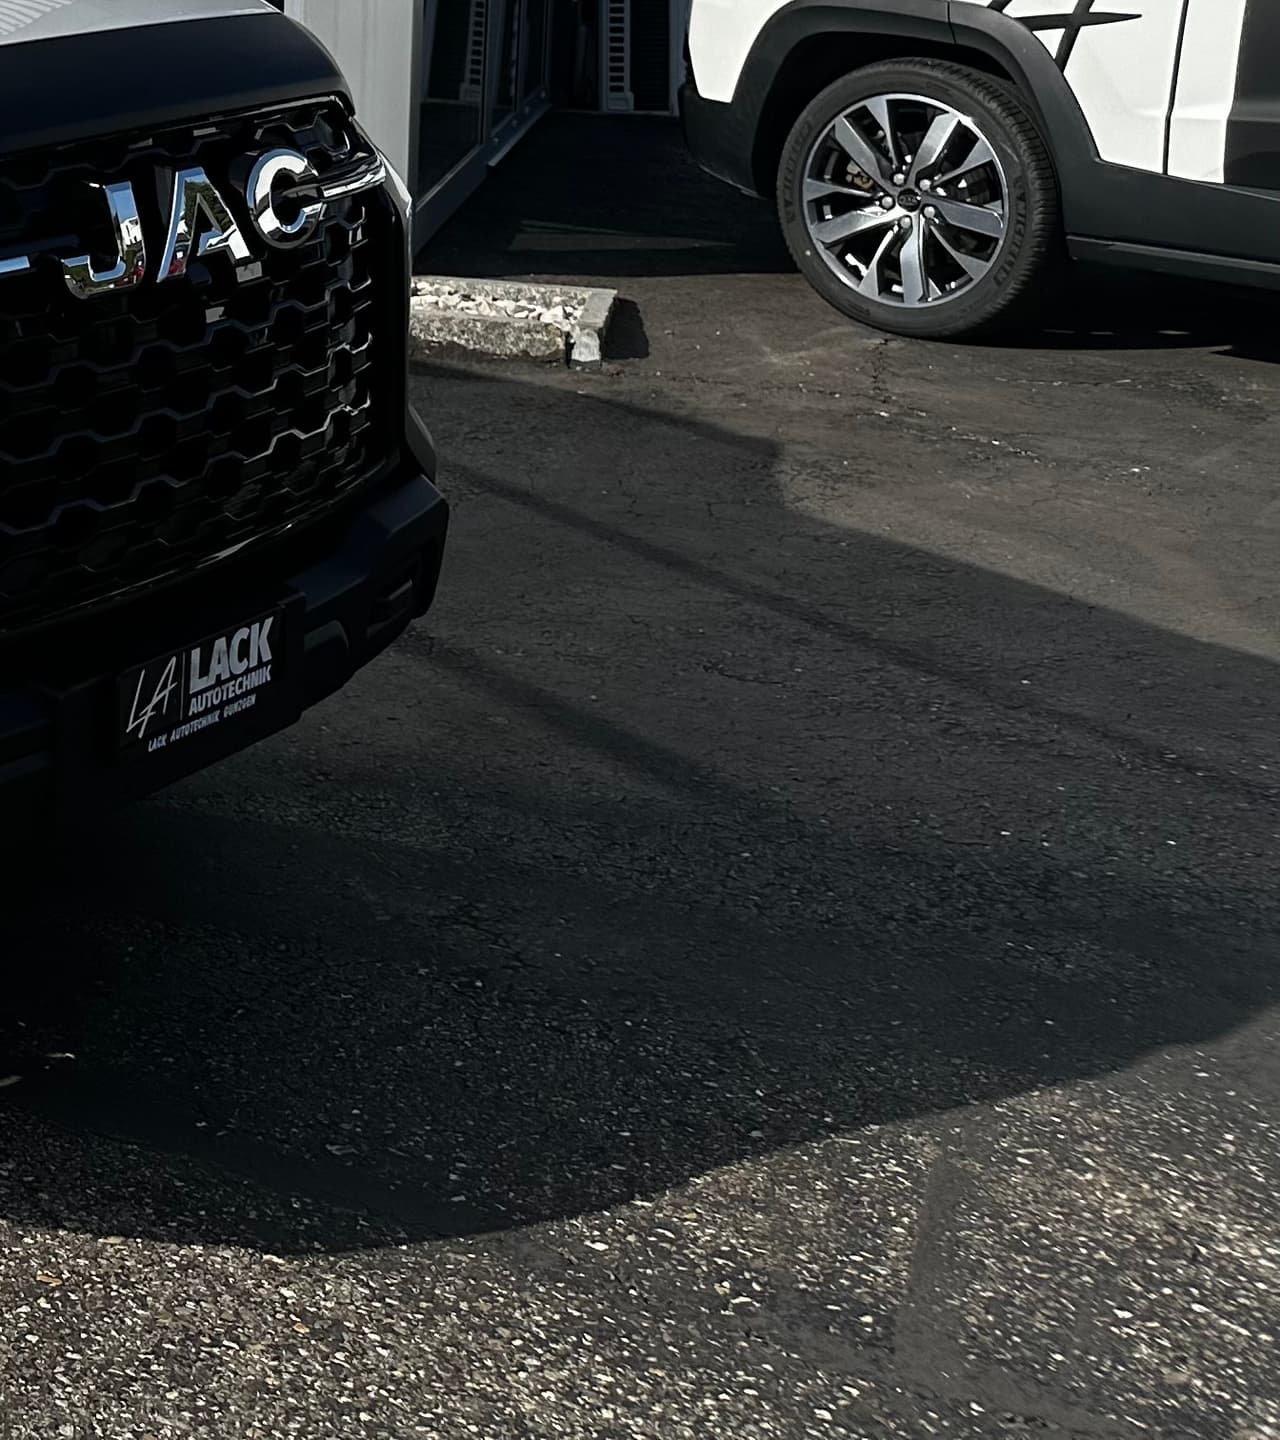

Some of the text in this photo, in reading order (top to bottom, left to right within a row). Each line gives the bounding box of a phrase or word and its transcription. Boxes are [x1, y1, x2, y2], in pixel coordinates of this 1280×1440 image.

[60, 147, 323, 299] JAC
[190, 665, 272, 716] AUTOTECHNIK
[191, 616, 274, 694] LACK
[126, 656, 178, 739] LA
[148, 734, 167, 752] LACK
[170, 711, 221, 742] AUTOTECHNIK
